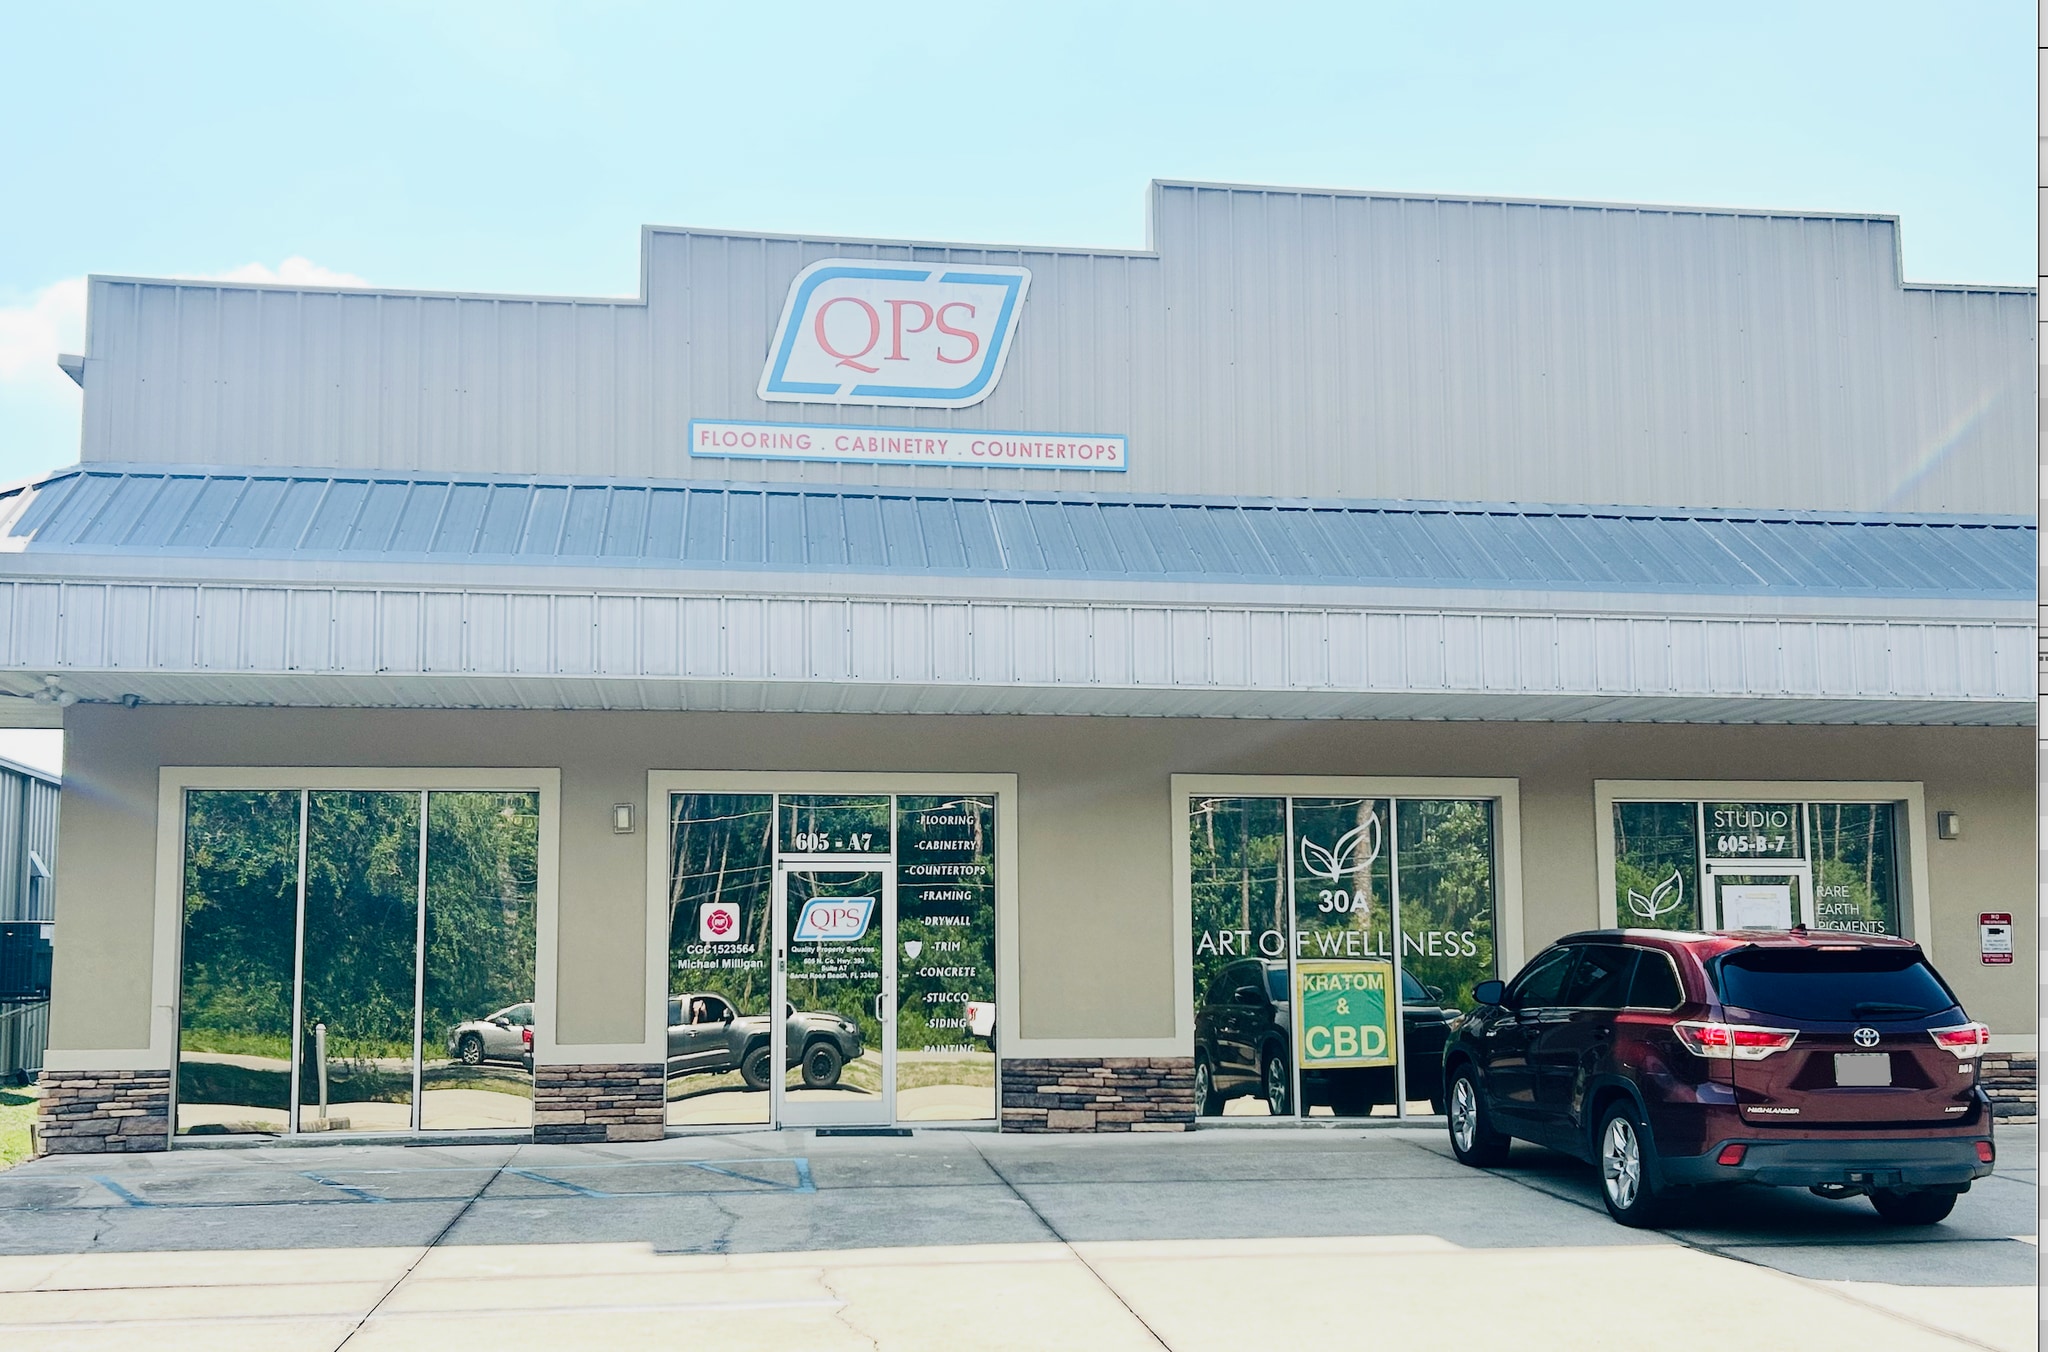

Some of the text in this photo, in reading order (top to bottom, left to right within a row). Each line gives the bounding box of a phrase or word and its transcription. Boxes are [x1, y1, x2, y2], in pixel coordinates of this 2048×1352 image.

[814, 296, 980, 374] QPS
[700, 430, 812, 450] FLOORING
[834, 436, 949, 455] CABINETRY
[970, 441, 1118, 461] COUNTERTOPS
[916, 815, 975, 825] -FLOORING
[1714, 810, 1788, 828] STUDIO
[795, 833, 830, 850] 605
[848, 833, 872, 850] A7
[914, 840, 977, 850] -CABINETRY
[1717, 835, 1786, 853] 605-B-7
[905, 865, 986, 876] -COUNTERTOPS
[919, 890, 972, 901] -FRAMING
[1816, 885, 1849, 898] RARE
[1318, 889, 1370, 913] 30A
[1817, 903, 1860, 915] EARTH
[810, 908, 860, 931] QPS
[920, 915, 971, 926] -DRYWALL
[1818, 920, 1885, 934] PIGMENTS
[931, 941, 961, 951] -TRIM
[1196, 930, 1252, 956] ART
[686, 944, 756, 956] CGC1523564
[791, 946, 816, 954] Quality
[816, 946, 846, 954] Property
[678, 958, 764, 971] Michael Milligan
[916, 967, 976, 977] -CONCRETE
[1303, 974, 1384, 991] KRATOM
[922, 992, 970, 1002] -STUCCO
[1336, 997, 1350, 1015] &
[925, 1018, 967, 1028] -SIDING
[1305, 1024, 1387, 1058] CBD
[1747, 1106, 1800, 1114] HIGHLANDER
